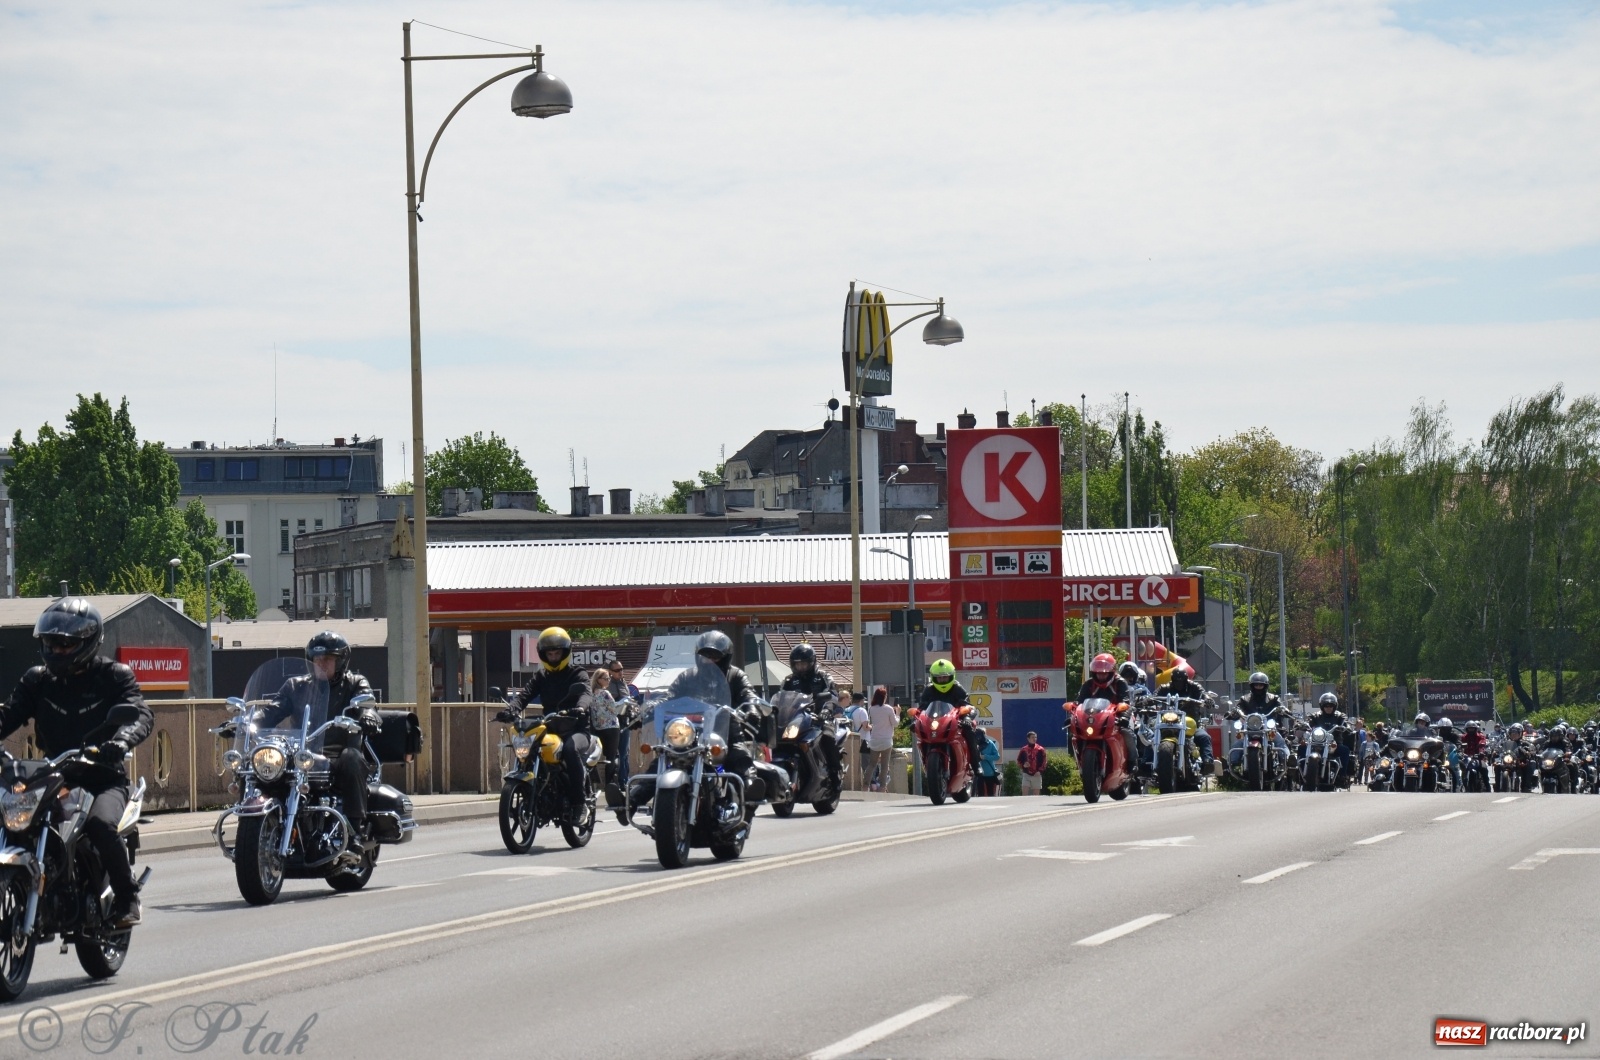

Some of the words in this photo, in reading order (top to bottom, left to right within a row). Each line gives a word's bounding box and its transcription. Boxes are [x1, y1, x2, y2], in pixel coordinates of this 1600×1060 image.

[969, 602, 982, 614] D
[967, 625, 984, 637] 95
[964, 649, 988, 659] LPG
[128, 659, 153, 671] MYJNIA
[154, 660, 182, 671] WYJAZD
[1451, 692, 1467, 700] sushi
[1474, 692, 1489, 701] grill
